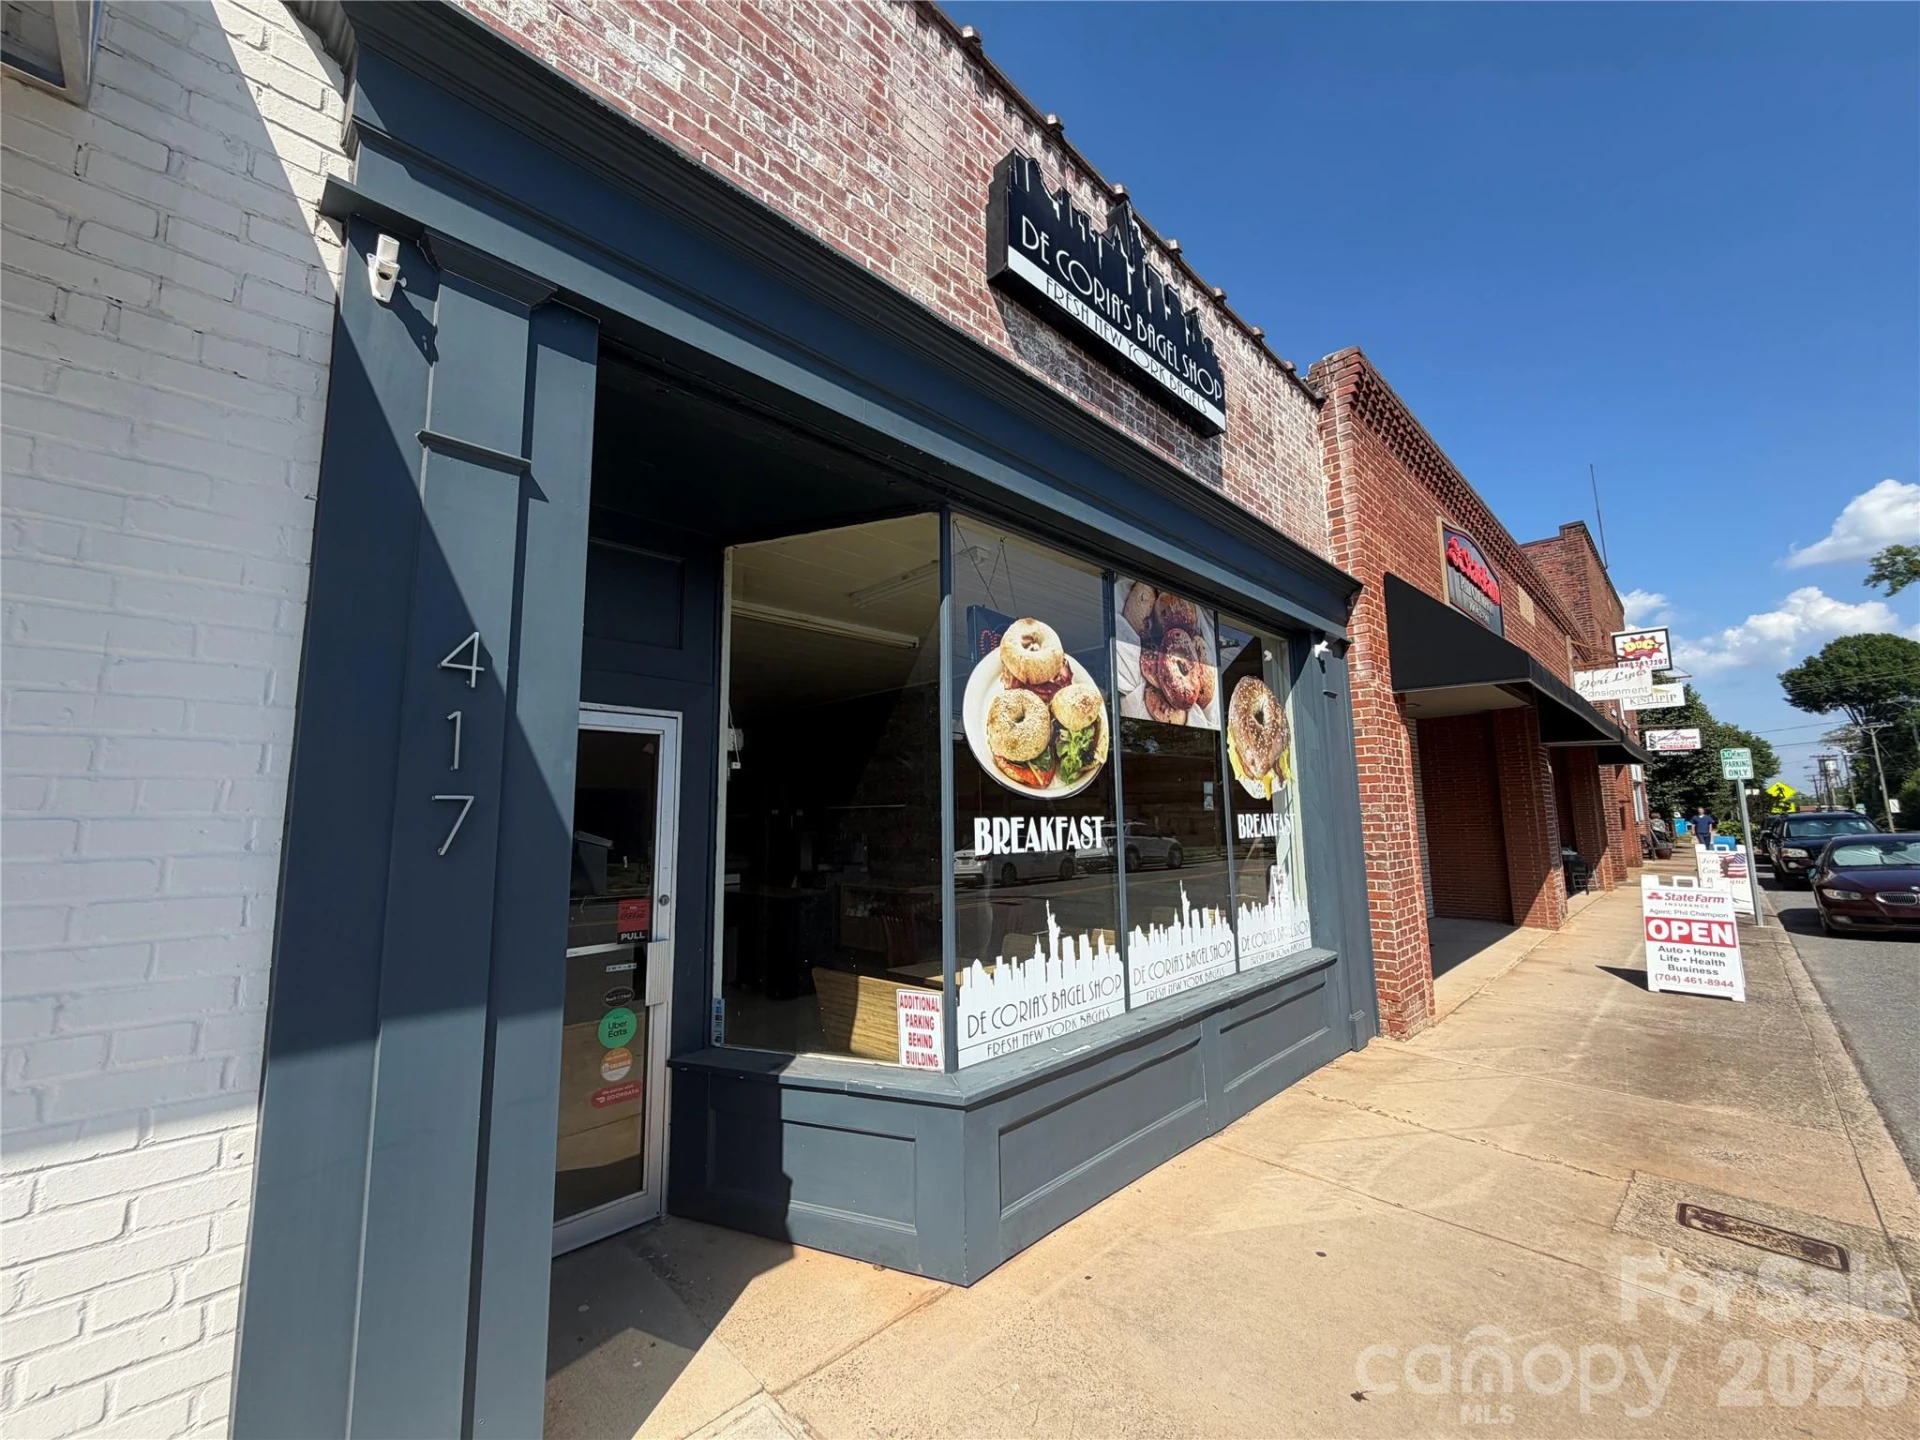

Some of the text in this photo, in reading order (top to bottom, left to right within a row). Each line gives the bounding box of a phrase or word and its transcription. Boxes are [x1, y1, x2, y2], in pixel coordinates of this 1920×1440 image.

[1022, 215, 1223, 402] DE CORIA'S BAGEL SHOP
[1045, 276, 1208, 414] FRESH NEW YORK BAGELS
[1724, 760, 1750, 768] PARKING
[974, 815, 1104, 856] BREAKFAST
[1237, 813, 1296, 840] BREAKFAST
[1664, 892, 1725, 904] State Farm
[1649, 908, 1673, 916] Agent:
[1690, 910, 1728, 919] Champion
[620, 931, 645, 941] PULL
[1647, 919, 1734, 946] OPEN
[1658, 945, 1726, 958] Auto Home
[1660, 954, 1726, 967] Life Health
[1133, 940, 1232, 987] DE CORIA'S BAGEL SHOP
[1668, 964, 1719, 976] Business
[1146, 967, 1225, 1002] FRESH NEW YORK BAGELS
[1655, 973, 1734, 988] (704) 461-8944
[900, 994, 940, 1013] ADDITIONAL
[967, 974, 1122, 1039] DE CORIA'S BAGEL SHOP
[608, 1020, 628, 1030] Uber
[905, 1013, 935, 1031] PARKING
[608, 1028, 628, 1038] Eats
[908, 1032, 933, 1049] BEHIND
[987, 1006, 1111, 1058] FRESH NEW YORK BAGELS
[906, 1050, 939, 1068] BUILDING
